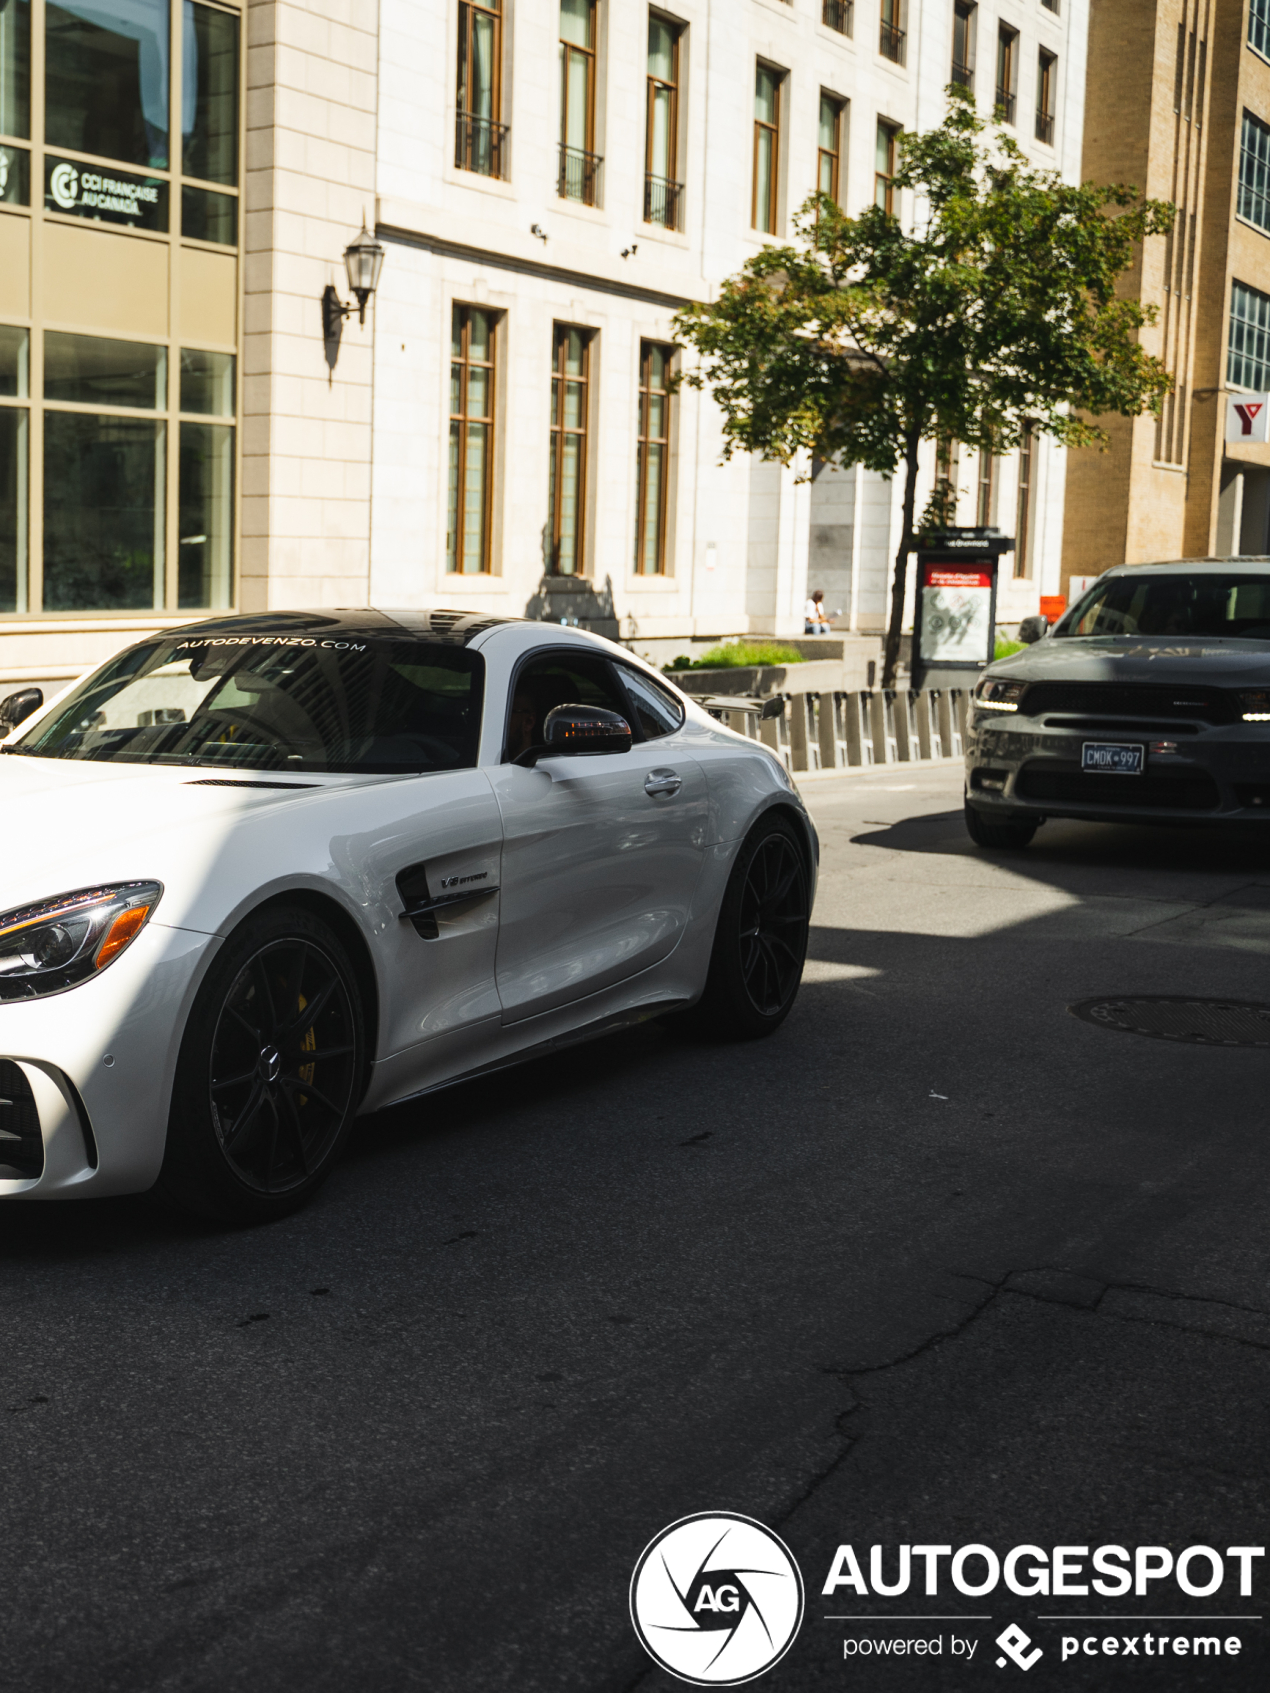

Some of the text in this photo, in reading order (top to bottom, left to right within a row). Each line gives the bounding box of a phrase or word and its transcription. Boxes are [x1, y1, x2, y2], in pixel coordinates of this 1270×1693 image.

[81, 173, 158, 203] CCI FRANÇAISE
[81, 191, 143, 215] AU CANADA
[176, 637, 367, 652] AUTODEVENZO.COM
